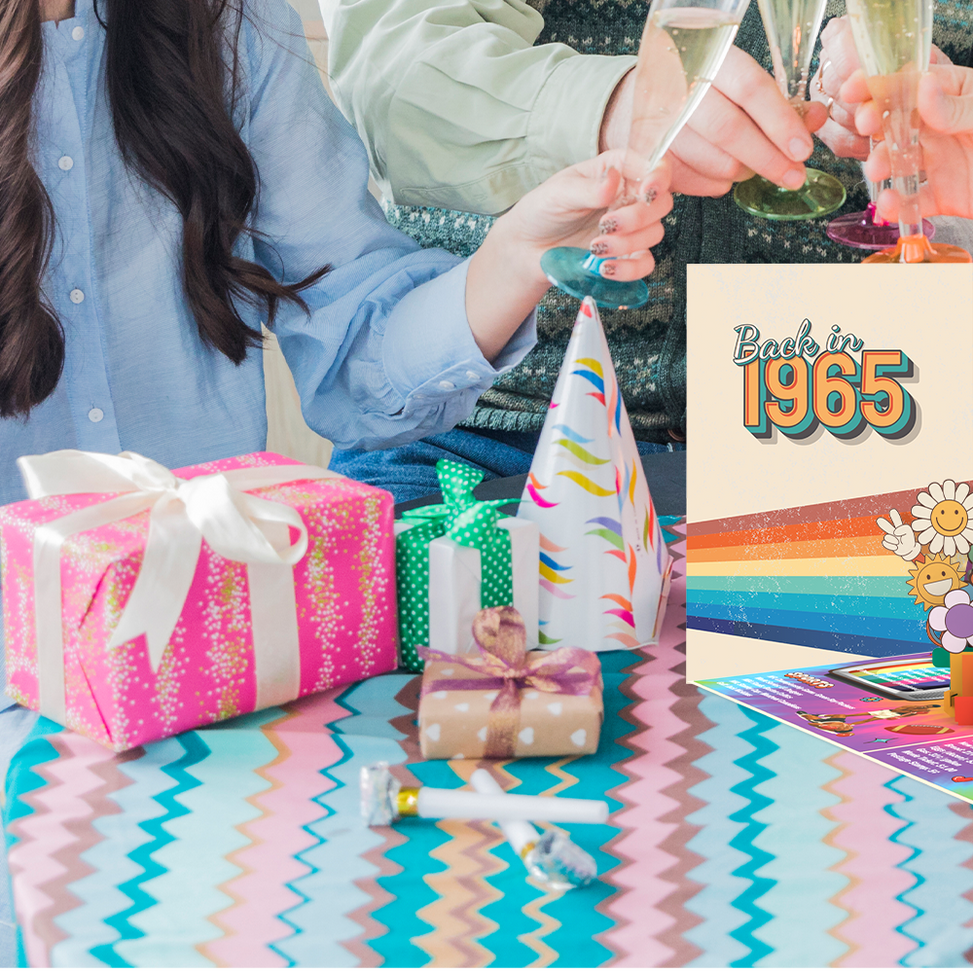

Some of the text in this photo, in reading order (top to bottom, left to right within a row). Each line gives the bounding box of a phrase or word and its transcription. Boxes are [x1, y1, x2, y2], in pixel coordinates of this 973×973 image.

[733, 318, 864, 366] Back in
[742, 348, 919, 442] 1965
